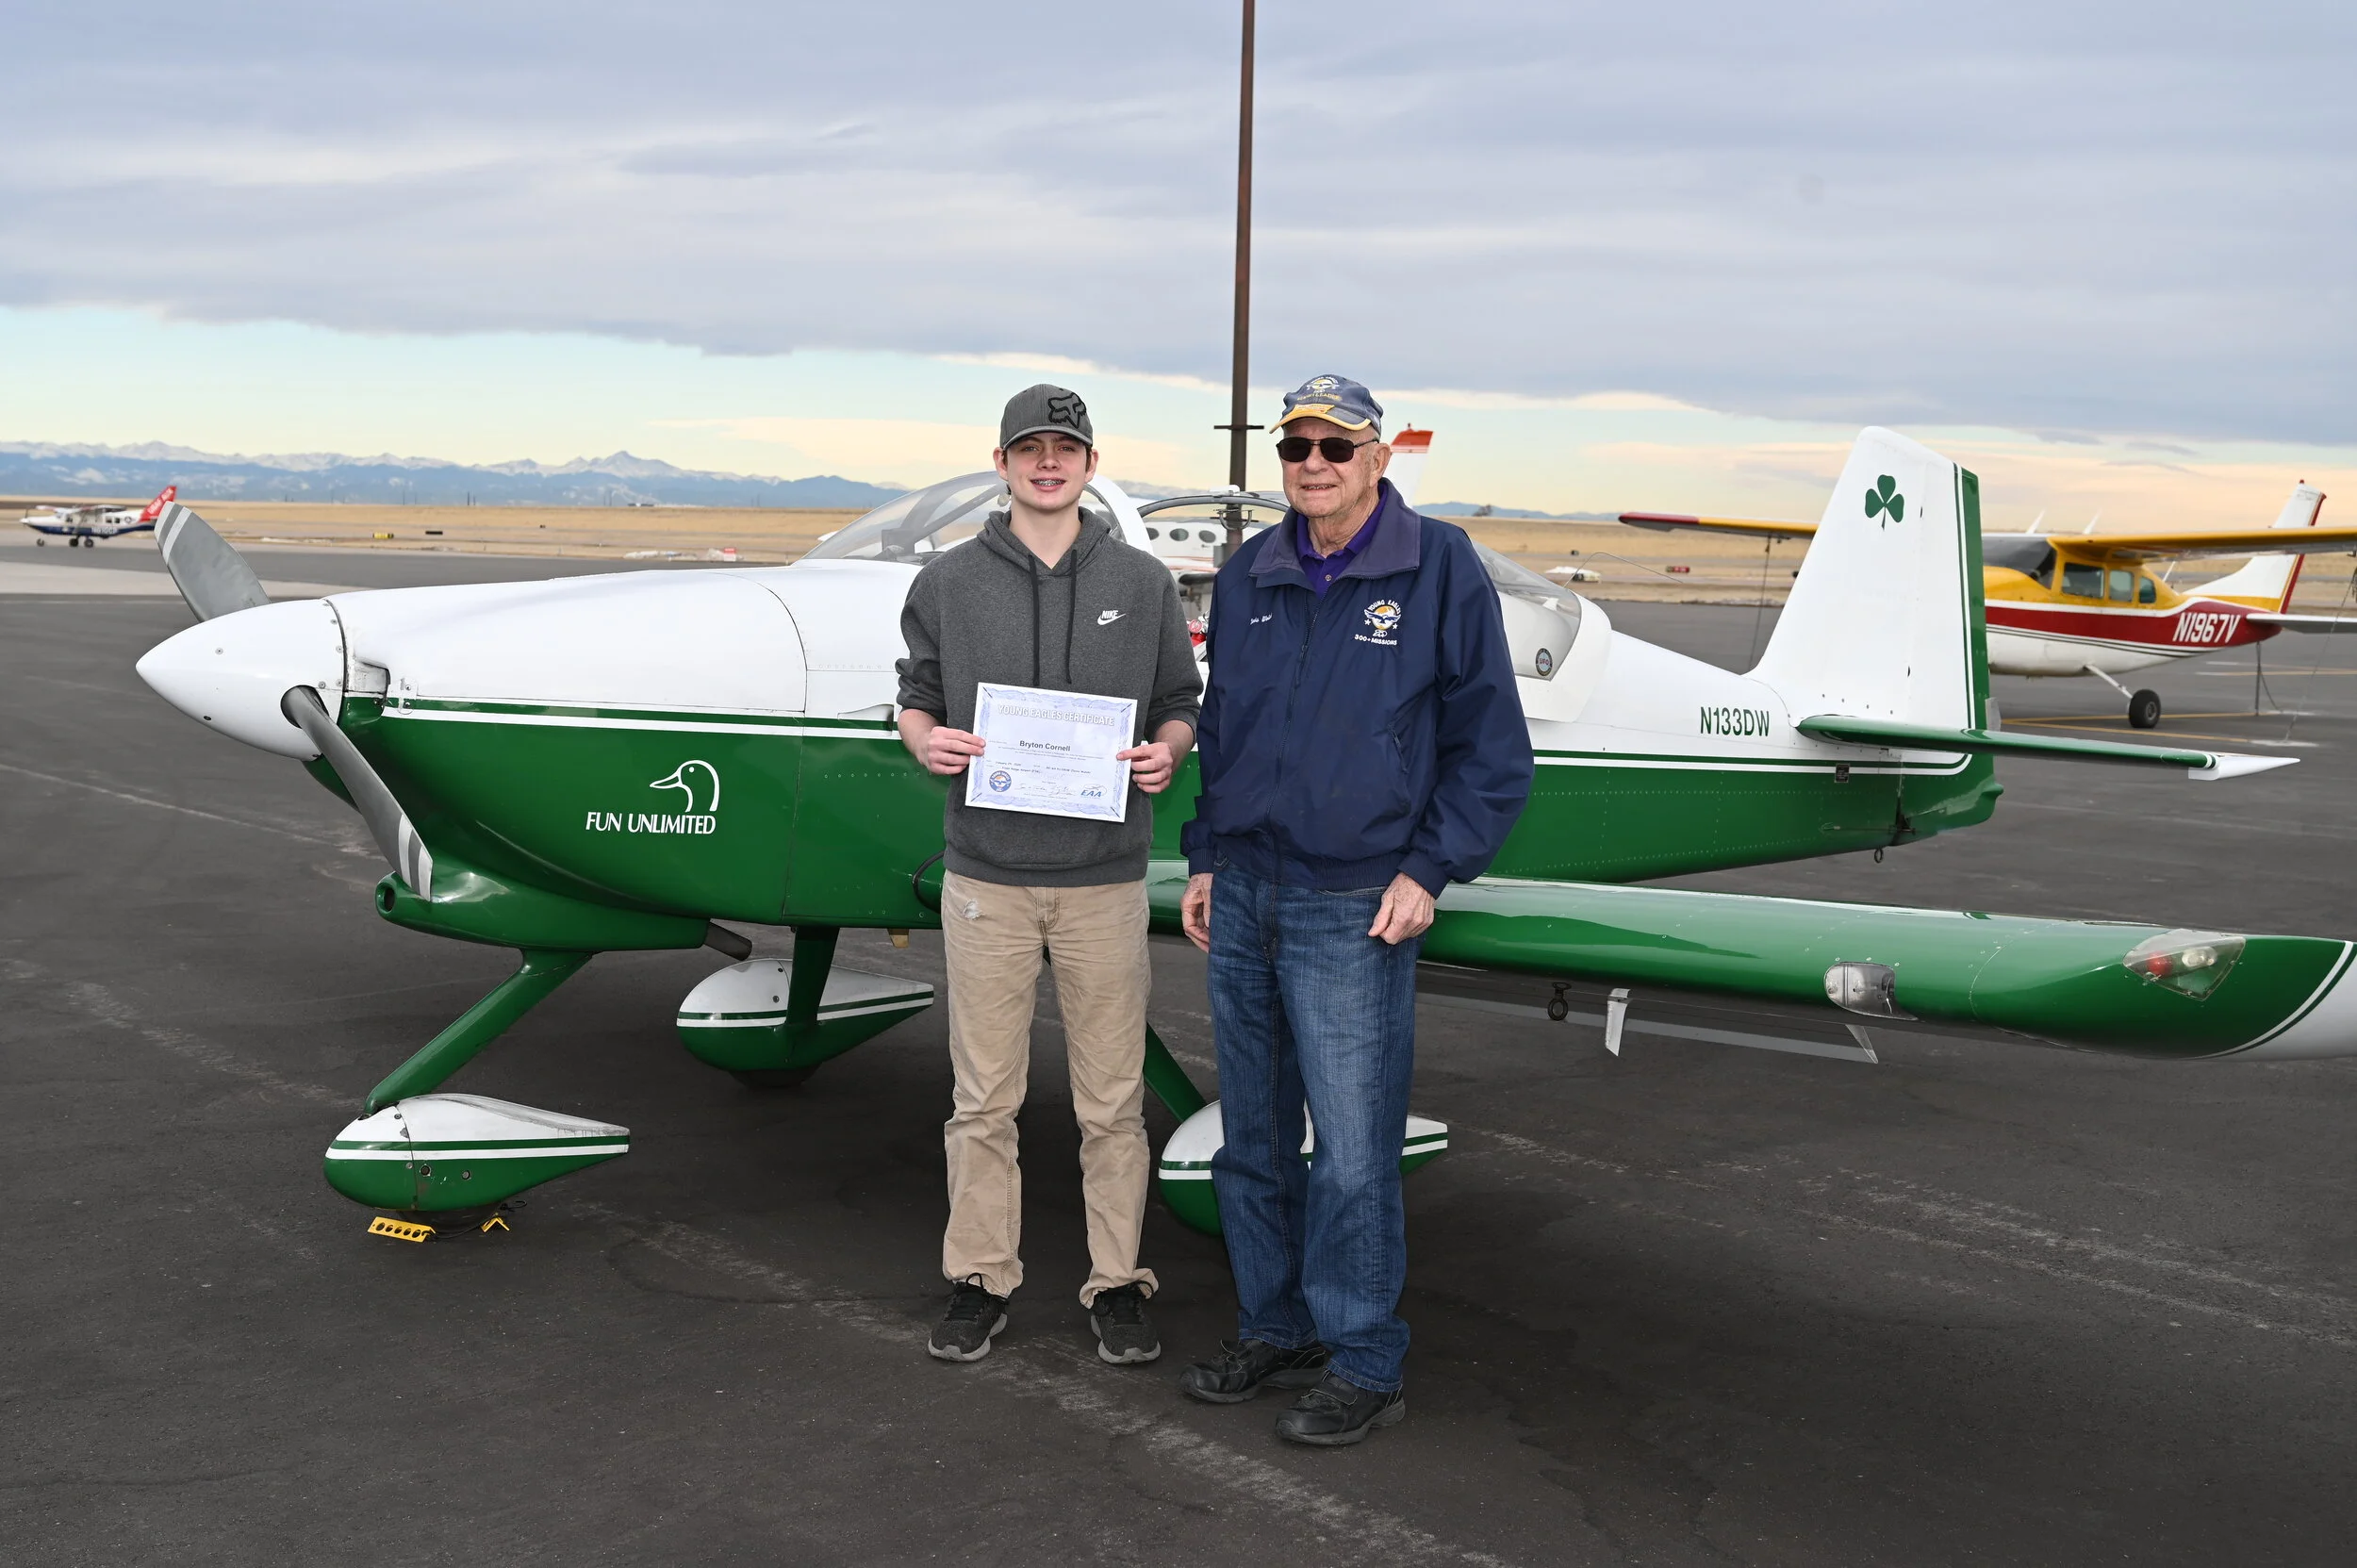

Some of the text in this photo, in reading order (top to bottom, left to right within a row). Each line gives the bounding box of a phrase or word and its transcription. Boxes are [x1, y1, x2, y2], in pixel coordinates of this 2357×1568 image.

[1367, 600, 1385, 611] YOUNG
[1101, 610, 1119, 619] NIKE
[2172, 612, 2241, 643] N1967V
[997, 704, 1115, 726] YOUNG EAGLES CERTIFICATE
[1700, 706, 1770, 736] N133DW
[1019, 740, 1071, 751] Bryton Cornell
[1080, 789, 1102, 798] EAA
[585, 811, 717, 834] FUN UNLIMITED
